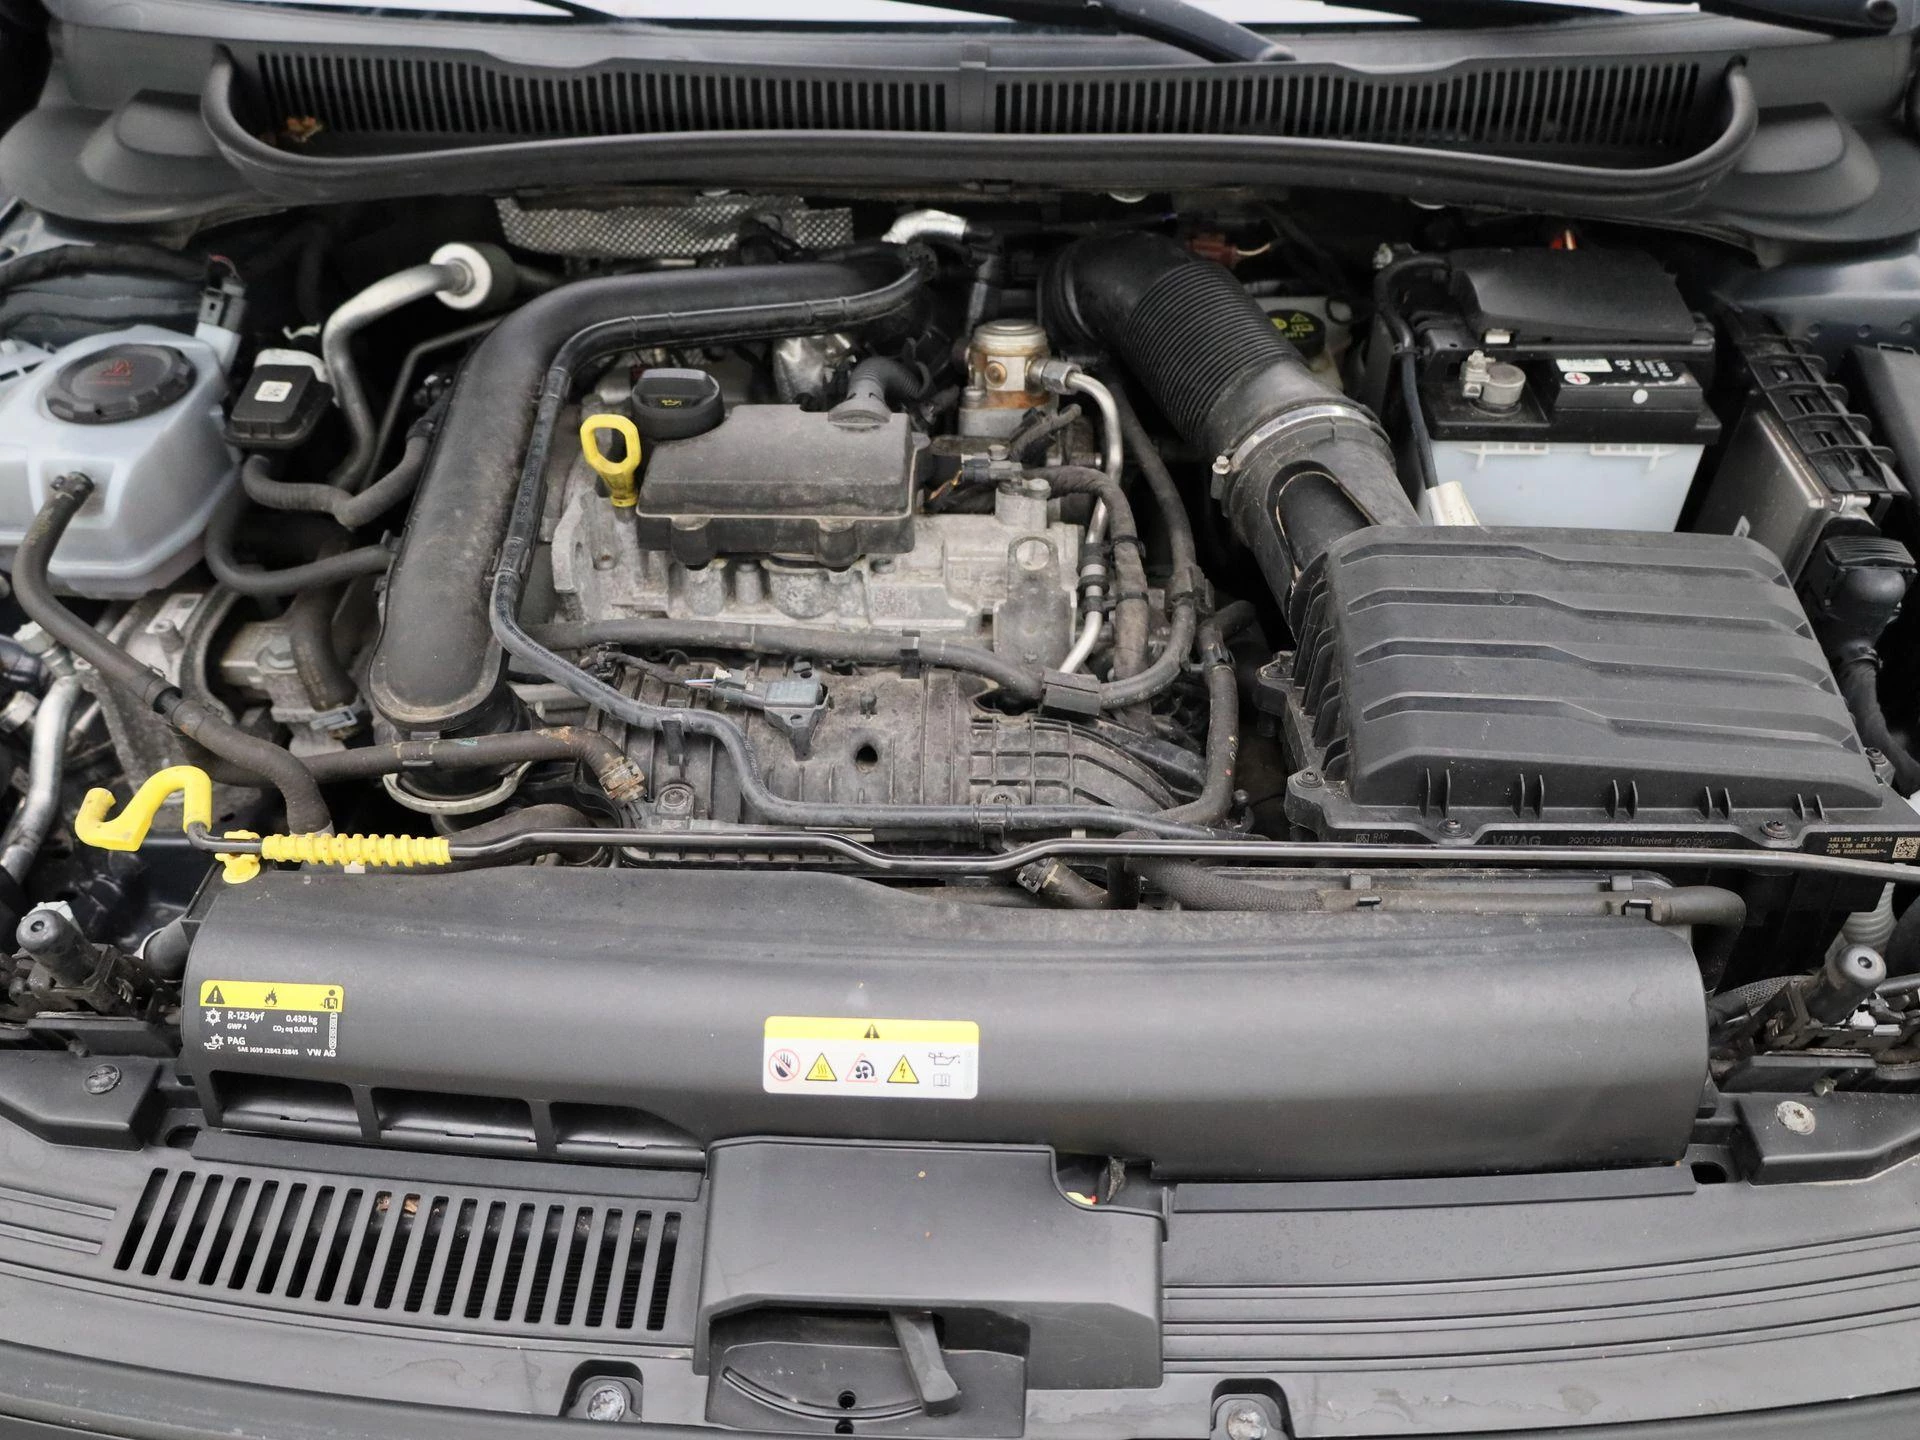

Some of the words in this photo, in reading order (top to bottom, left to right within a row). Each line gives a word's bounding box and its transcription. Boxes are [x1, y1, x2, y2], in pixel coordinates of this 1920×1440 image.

[227, 1011, 265, 1023] R-1234yf
[285, 1014, 307, 1024] 0.430
[308, 1016, 318, 1026] kg
[227, 1036, 246, 1046] PAG
[306, 1048, 321, 1057] VW
[323, 1049, 337, 1058] AG
